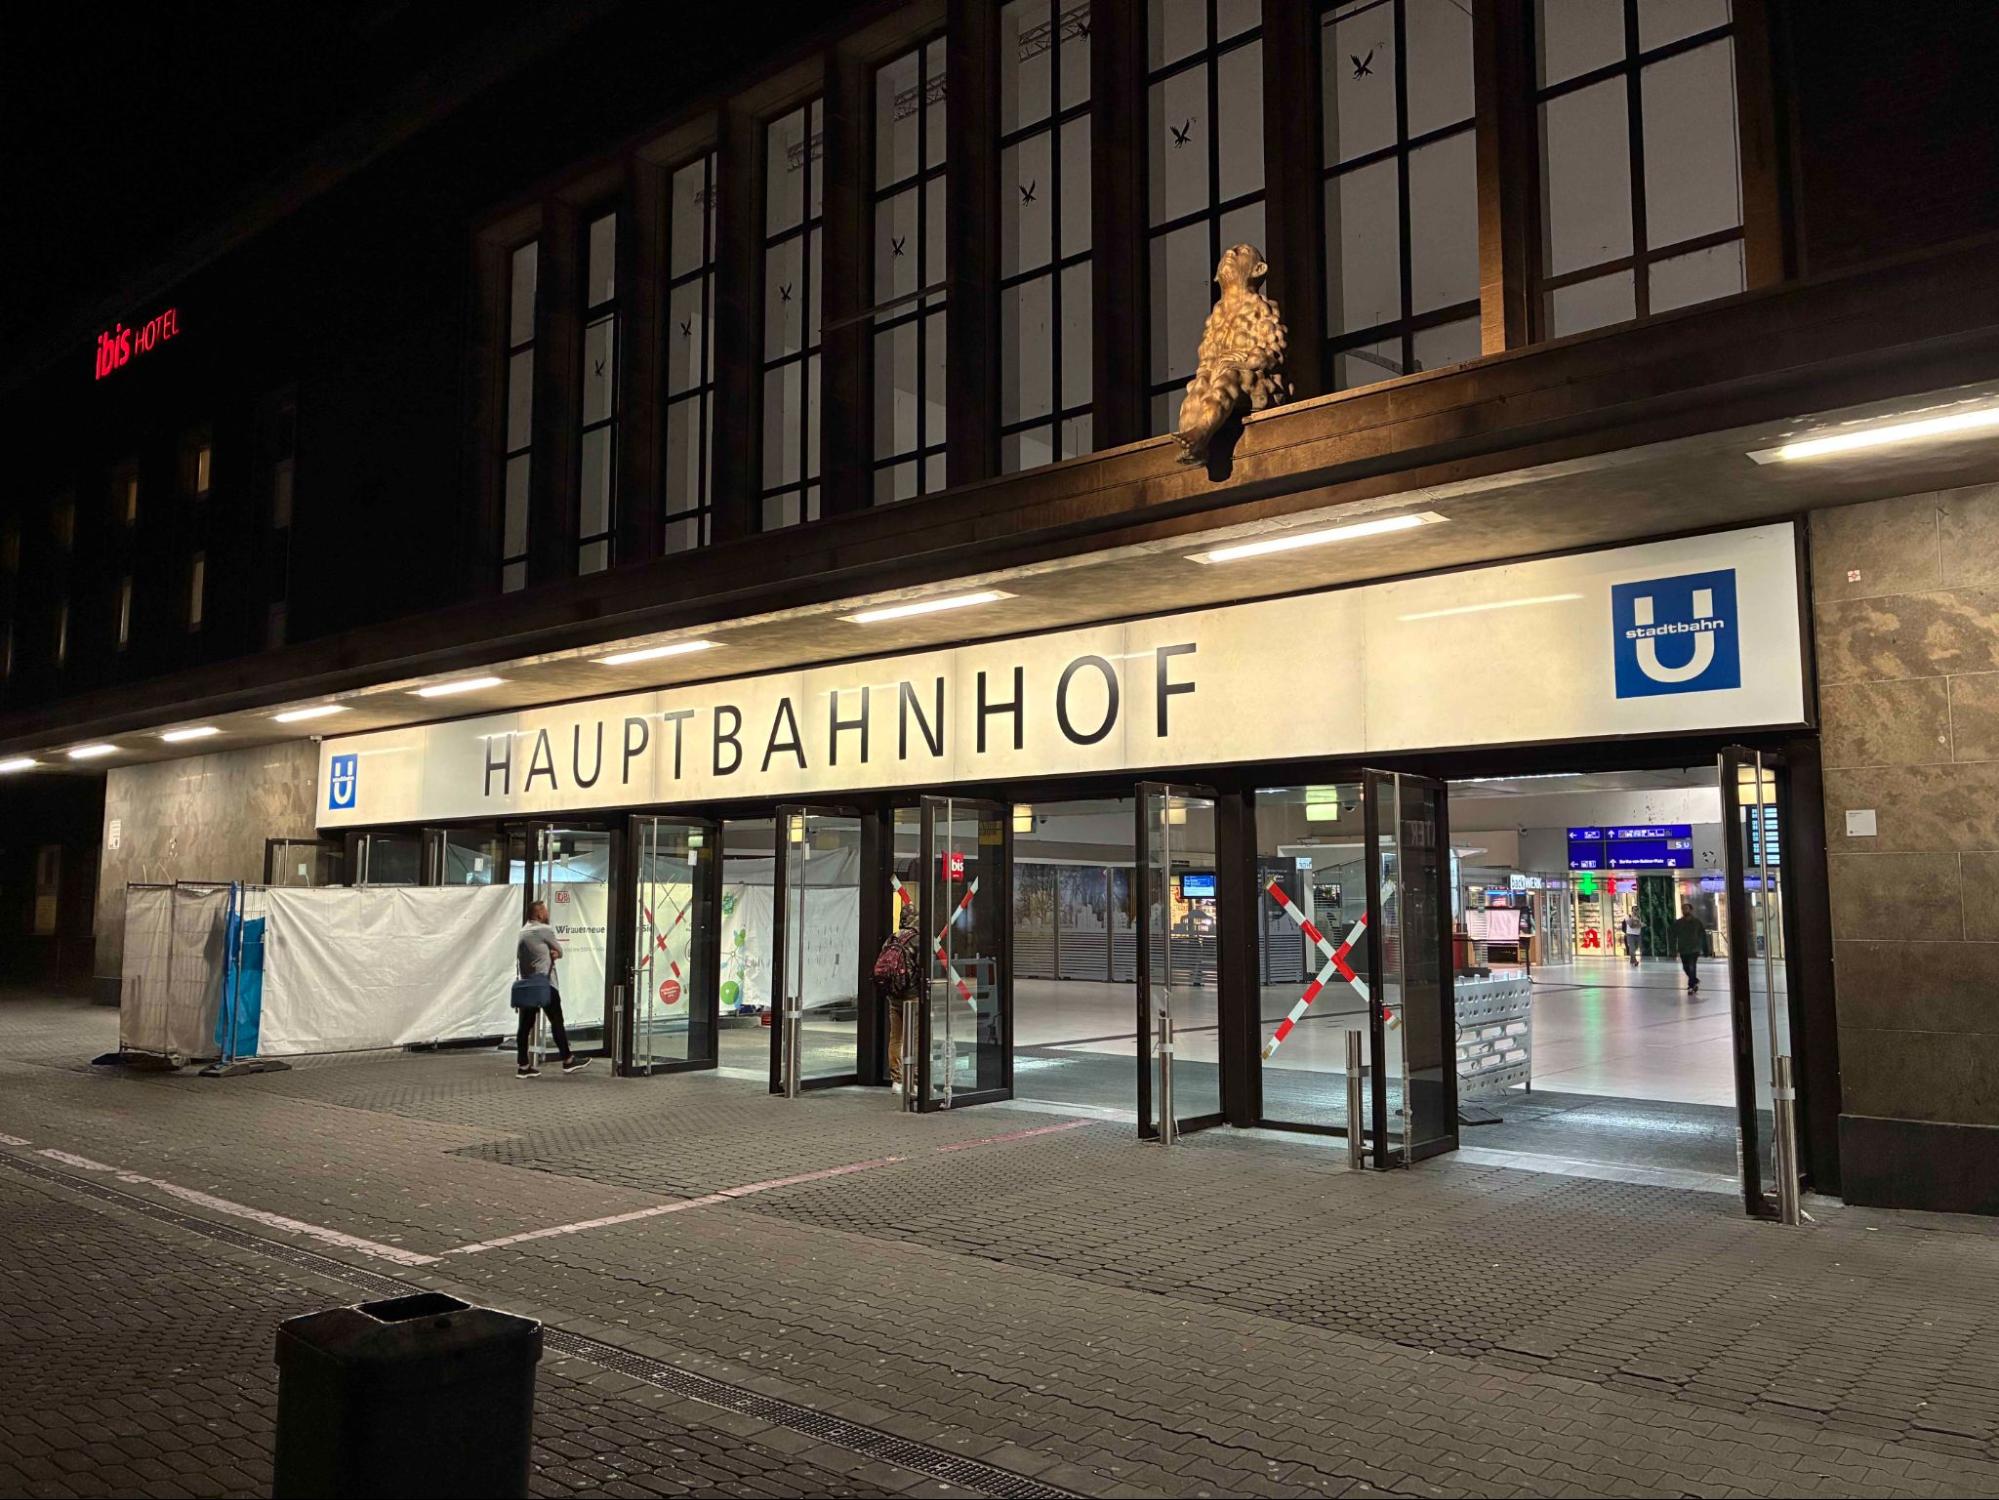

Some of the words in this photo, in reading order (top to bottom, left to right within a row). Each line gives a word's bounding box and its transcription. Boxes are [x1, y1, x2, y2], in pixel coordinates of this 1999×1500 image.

[95, 323, 131, 380] ibis
[134, 307, 180, 355] HOTEL
[1625, 619, 1725, 639] stadtbahn
[482, 642, 1197, 797] HAUPTBAHNHOF
[556, 891, 570, 903] DB
